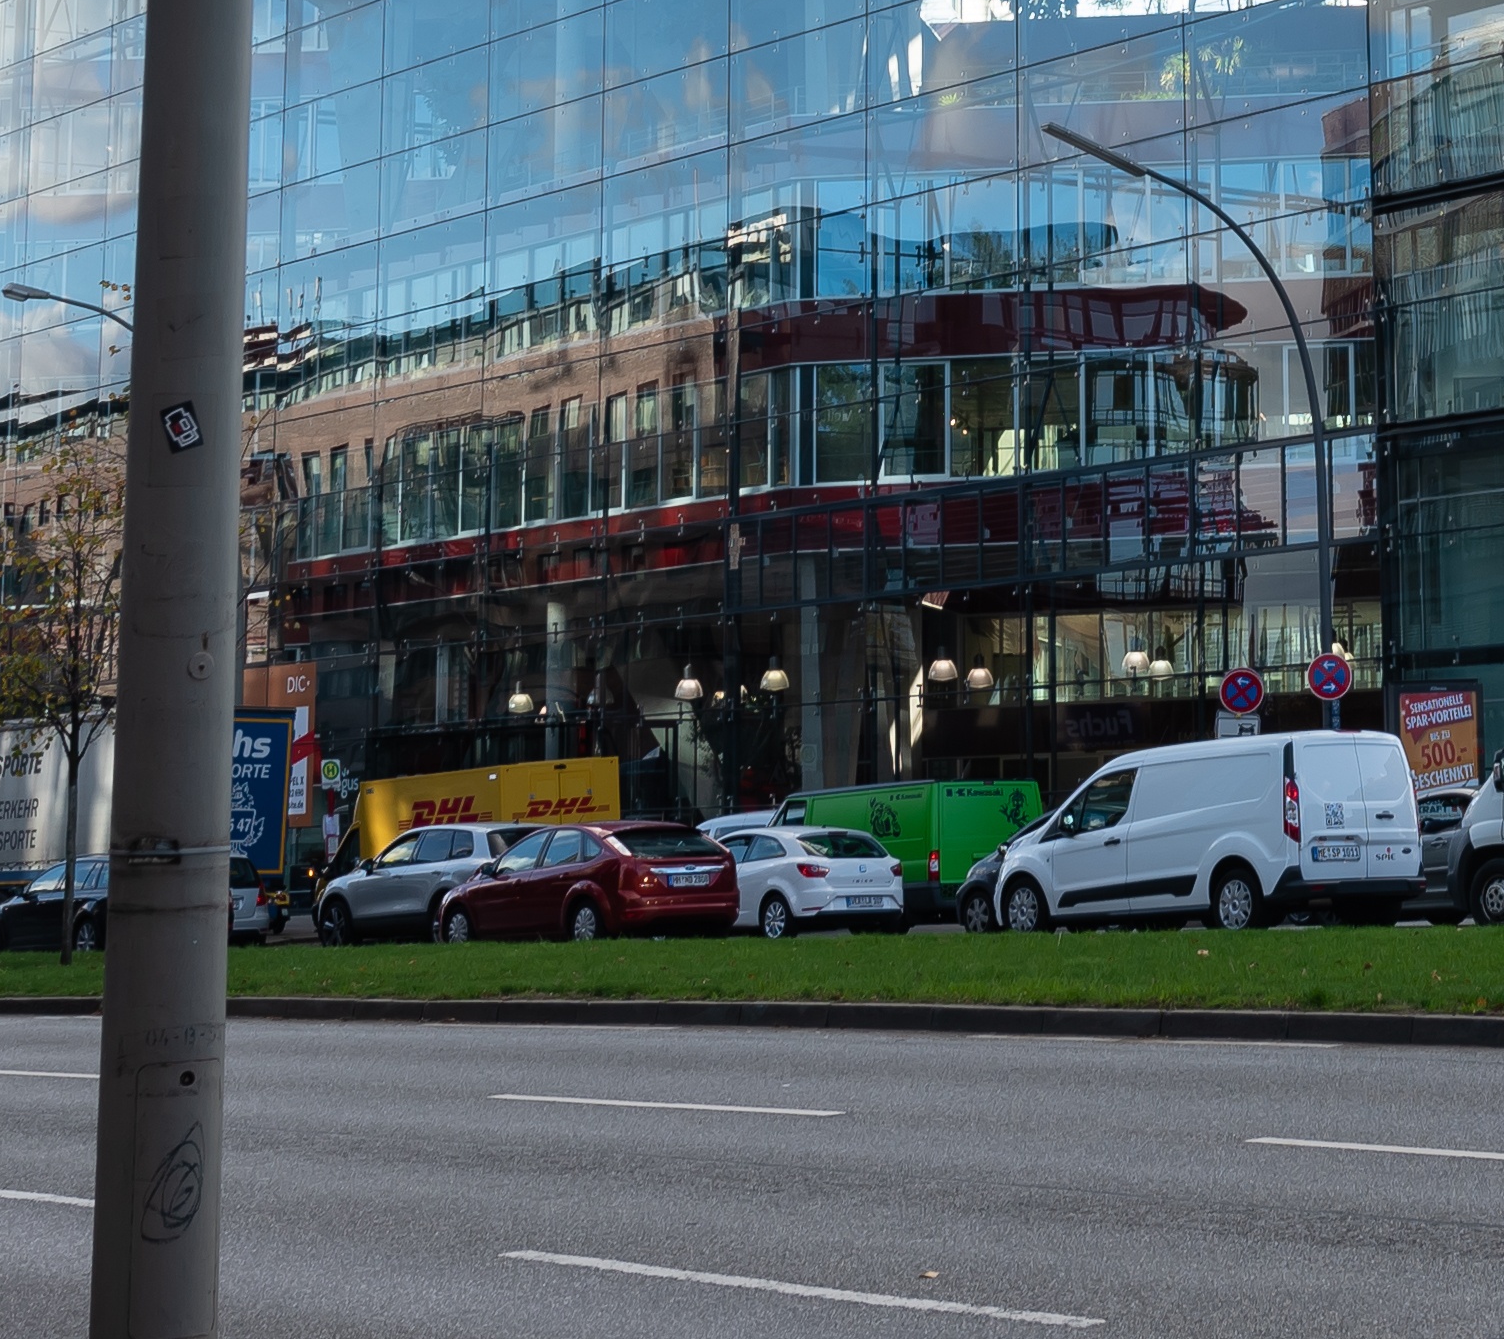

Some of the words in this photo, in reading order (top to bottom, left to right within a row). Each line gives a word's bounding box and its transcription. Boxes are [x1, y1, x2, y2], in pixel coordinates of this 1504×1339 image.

[1405, 704, 1473, 731] SPAR-VORTEILE!
[1409, 693, 1464, 715] SENSATIONELLE
[410, 795, 481, 829] DHL
[525, 796, 598, 819] DHL
